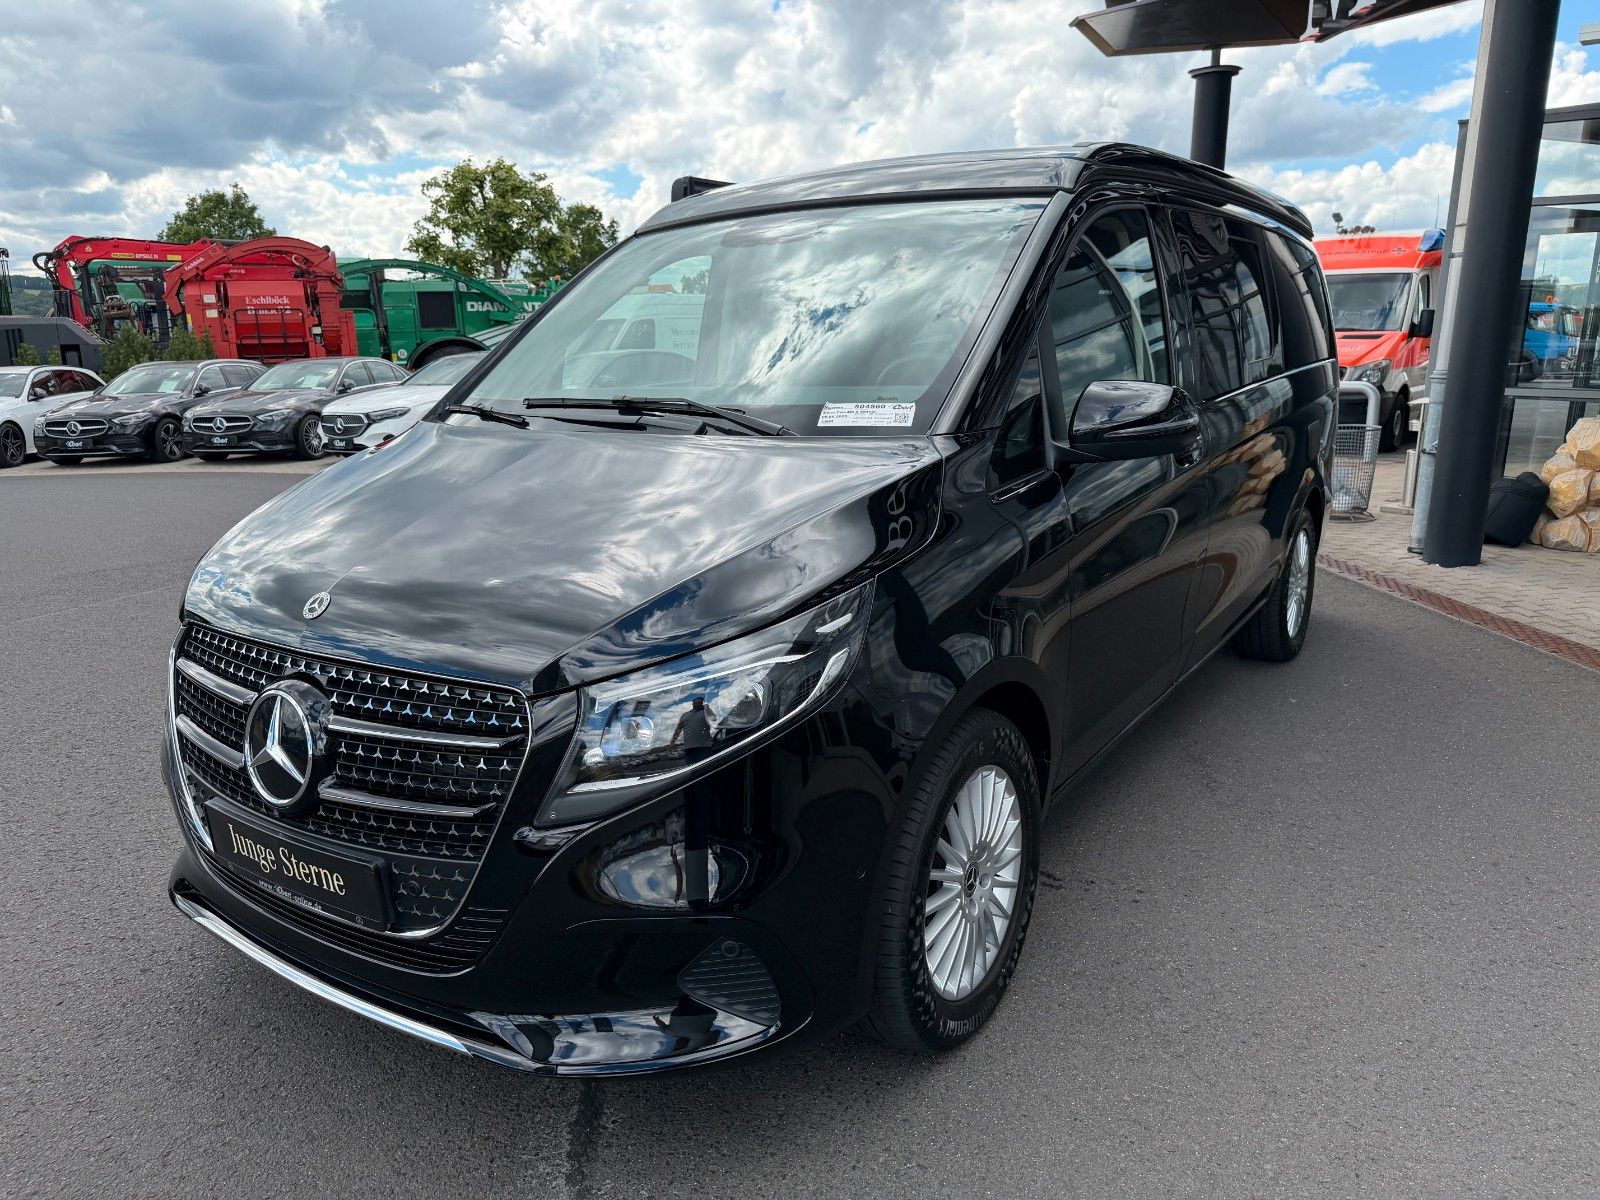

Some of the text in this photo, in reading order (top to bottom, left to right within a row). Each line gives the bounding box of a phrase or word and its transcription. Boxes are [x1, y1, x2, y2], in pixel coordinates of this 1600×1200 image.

[245, 296, 290, 305] Eschlböck
[227, 823, 346, 896] Junge Sterne
